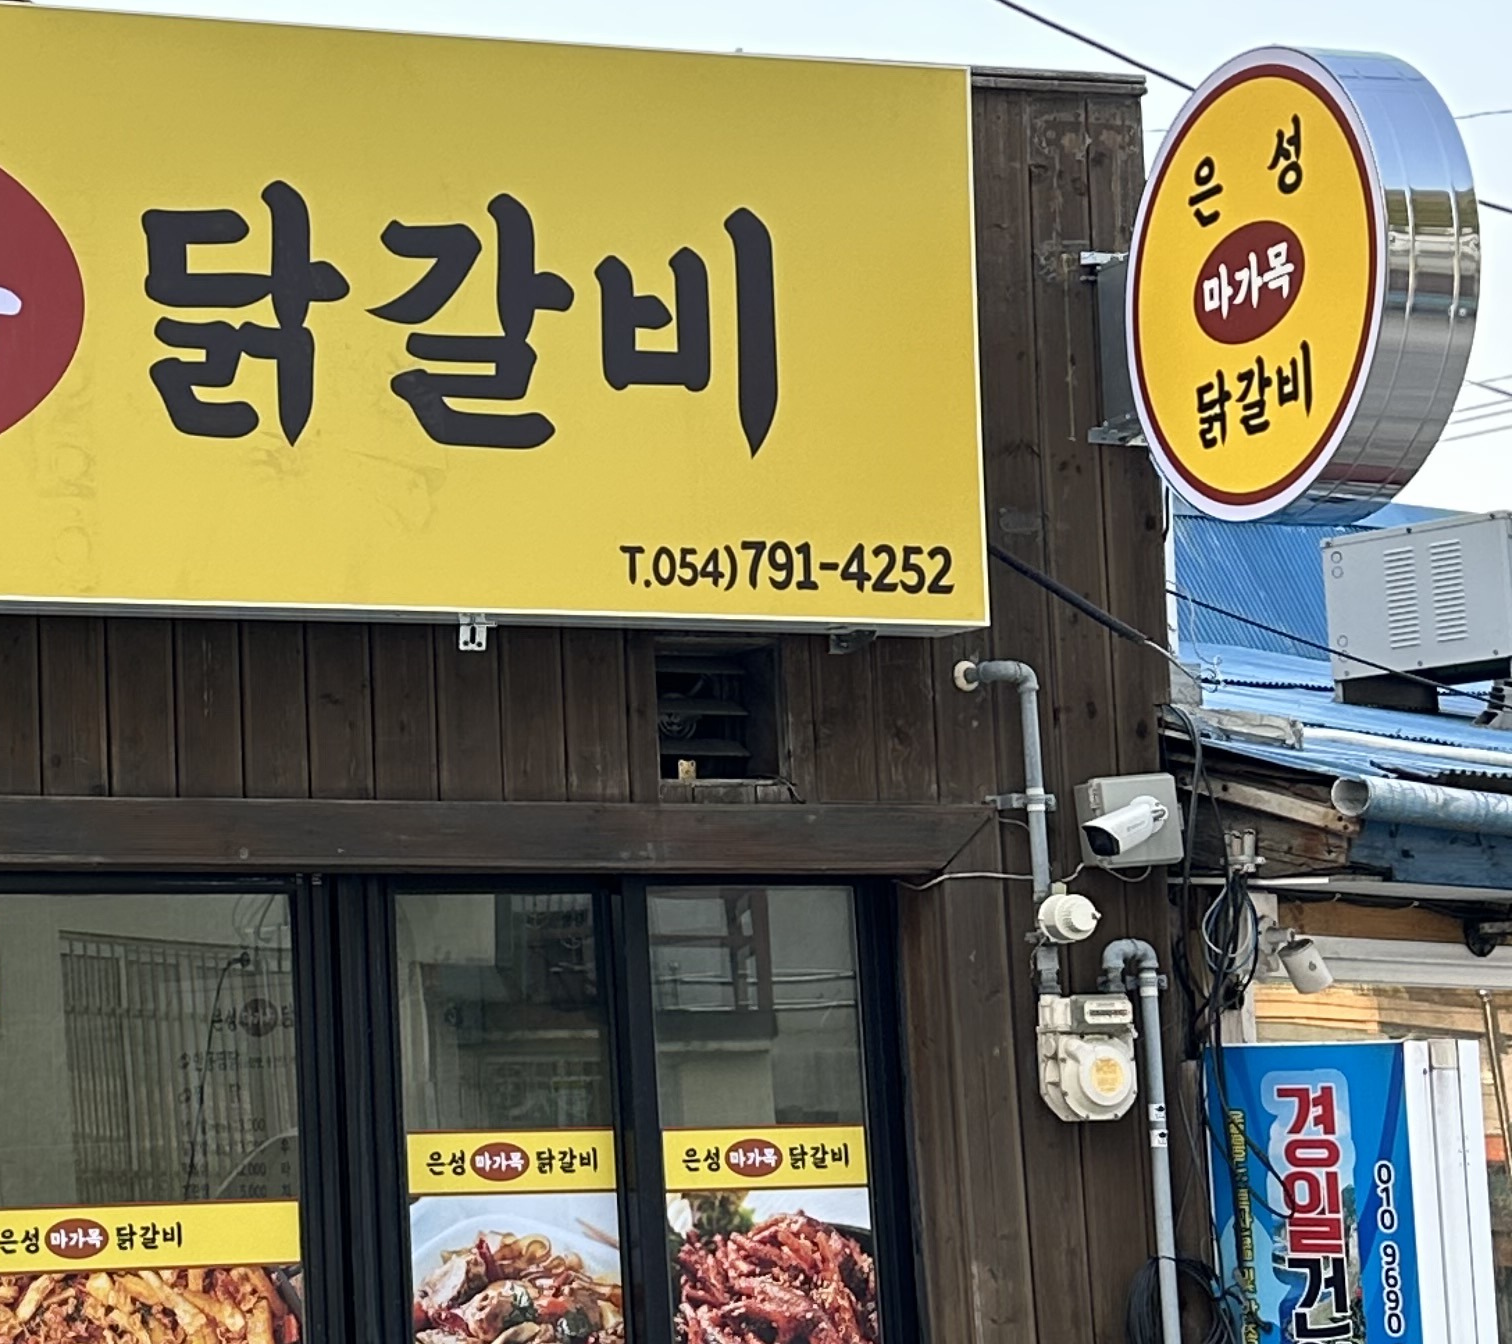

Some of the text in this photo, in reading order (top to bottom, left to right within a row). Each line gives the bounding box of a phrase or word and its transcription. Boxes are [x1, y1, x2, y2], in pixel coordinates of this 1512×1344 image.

[1203, 241, 1295, 320] 마가목
[141, 180, 779, 459] 닭갈비
[1195, 340, 1313, 449] 닭갈비
[620, 541, 955, 596] T.054)791-4252
[426, 1147, 599, 1176] 은성 마가목 닭갈비
[682, 1142, 850, 1173] 은성 마가목 닭갈비
[1375, 1161, 1395, 1232] 010
[49, 1228, 104, 1249] 마가목
[116, 1221, 183, 1252] 닭갈비
[1381, 1242, 1406, 1337] 9690
